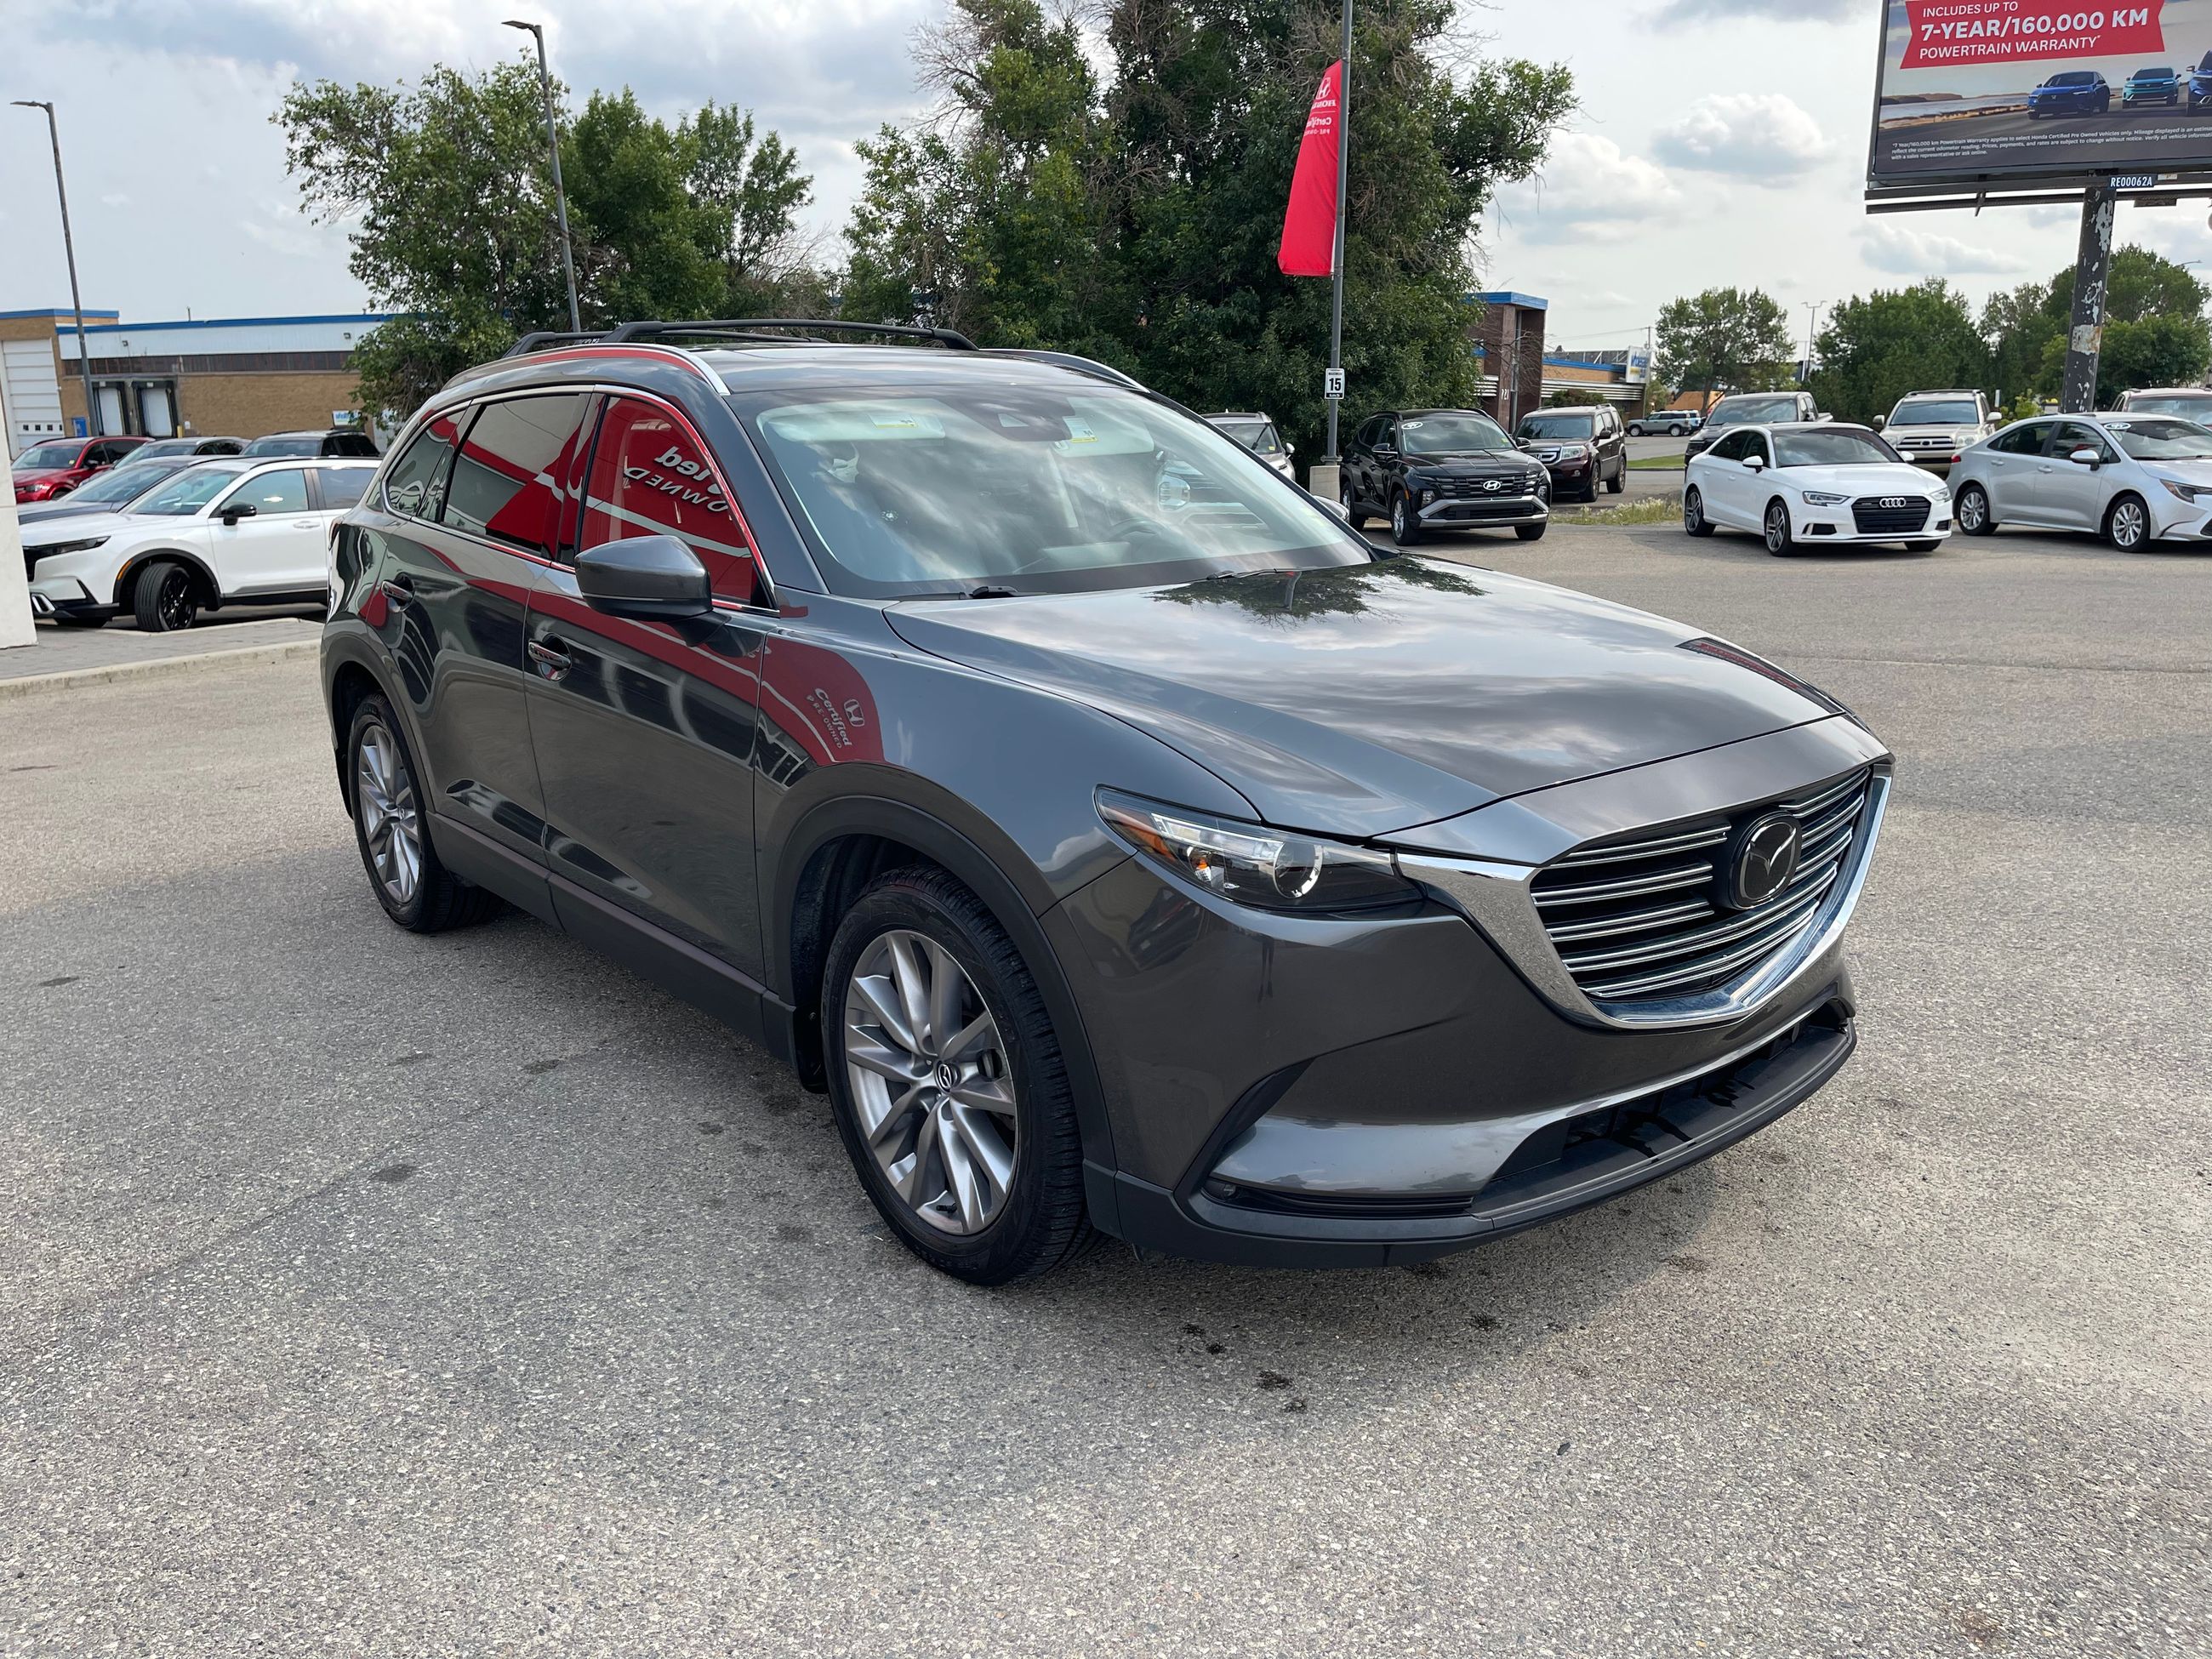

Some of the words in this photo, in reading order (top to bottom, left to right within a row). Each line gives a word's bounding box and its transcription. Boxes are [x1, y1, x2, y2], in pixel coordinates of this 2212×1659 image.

[1923, 3, 1981, 17] INCLUDES
[1984, 2, 2000, 13] UP
[2003, 1, 2019, 12] TO
[1921, 11, 2105, 41] 7-YEAR/160,000
[2112, 8, 2148, 27] KM
[1919, 42, 2011, 60] POWERTRAIN
[2110, 176, 2152, 187] RE00062A
[1329, 378, 1342, 391] 15
[814, 687, 852, 746] Certified
